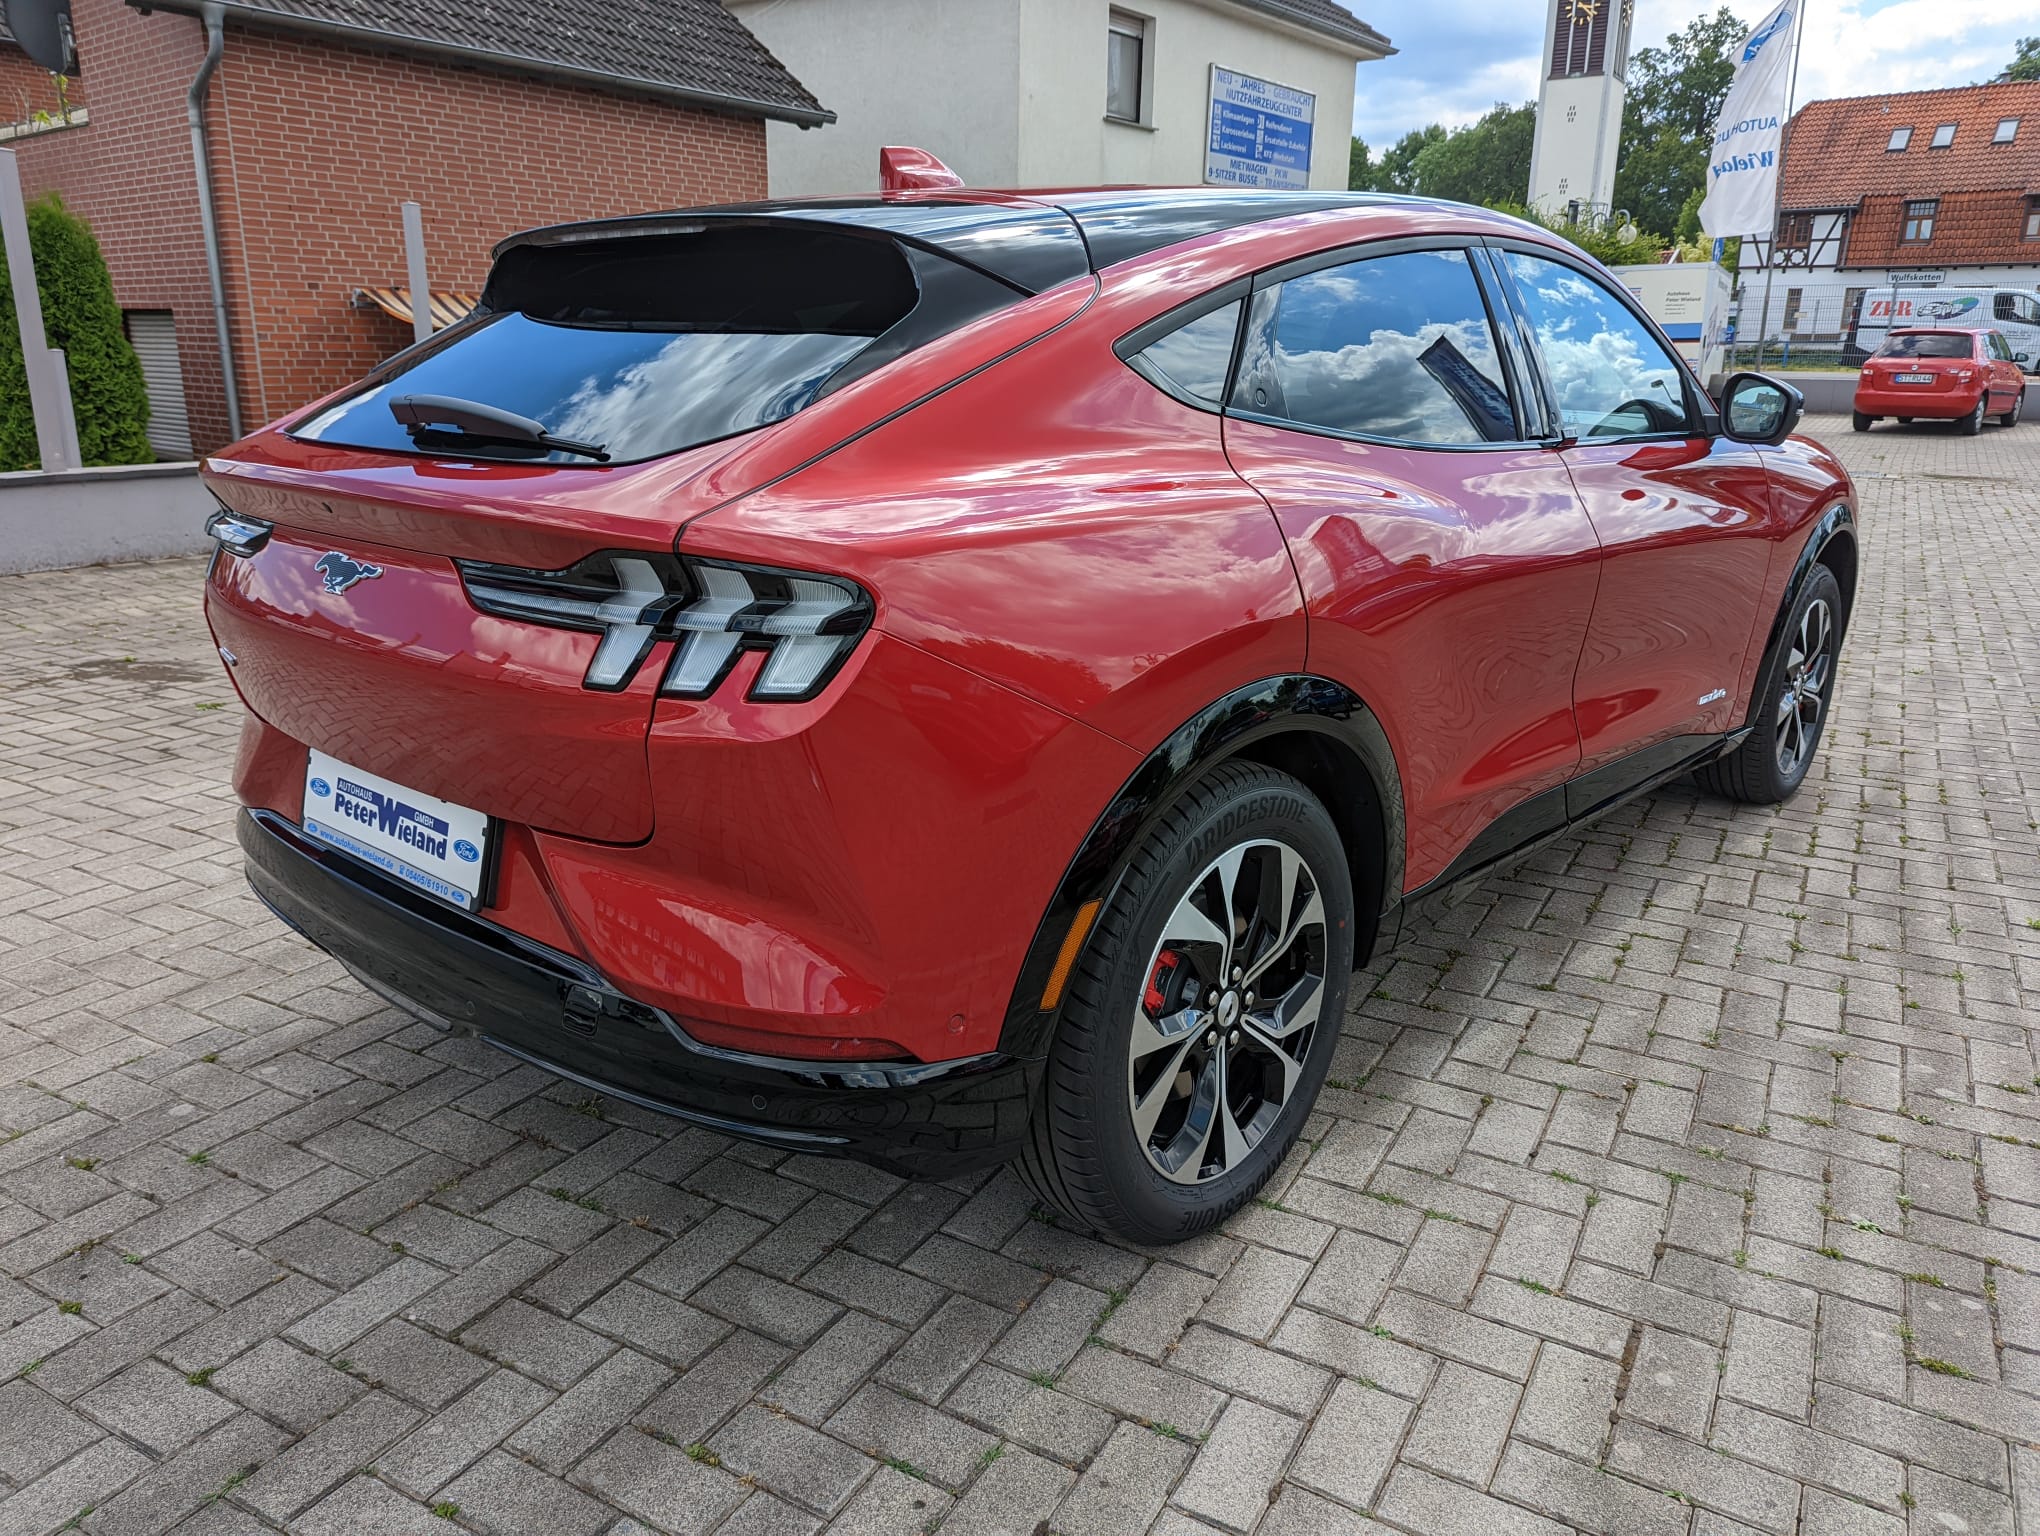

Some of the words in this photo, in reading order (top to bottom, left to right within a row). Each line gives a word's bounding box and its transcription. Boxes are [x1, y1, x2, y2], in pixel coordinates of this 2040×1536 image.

[1217, 71, 1232, 85] NEU
[1240, 77, 1265, 94] JAHRES
[1273, 87, 1311, 107] GEBRAUCHT
[1225, 87, 1302, 118] NUTZFAHRZEUGCENTER
[1230, 159, 1268, 176] MIETWAGEN
[1274, 169, 1289, 180] PKW
[1238, 173, 1258, 186] BUSSE
[1890, 273, 1941, 282] Wulfskotten
[312, 780, 329, 796] Ford
[338, 780, 373, 801] AUTOHAUS
[414, 812, 434, 828] GMBH
[1185, 795, 1312, 871] BRIDGESTONE
[319, 829, 395, 870] www.autohaus-wieland.de
[456, 841, 475, 861] Ford
[405, 868, 449, 896] 05405/61910
